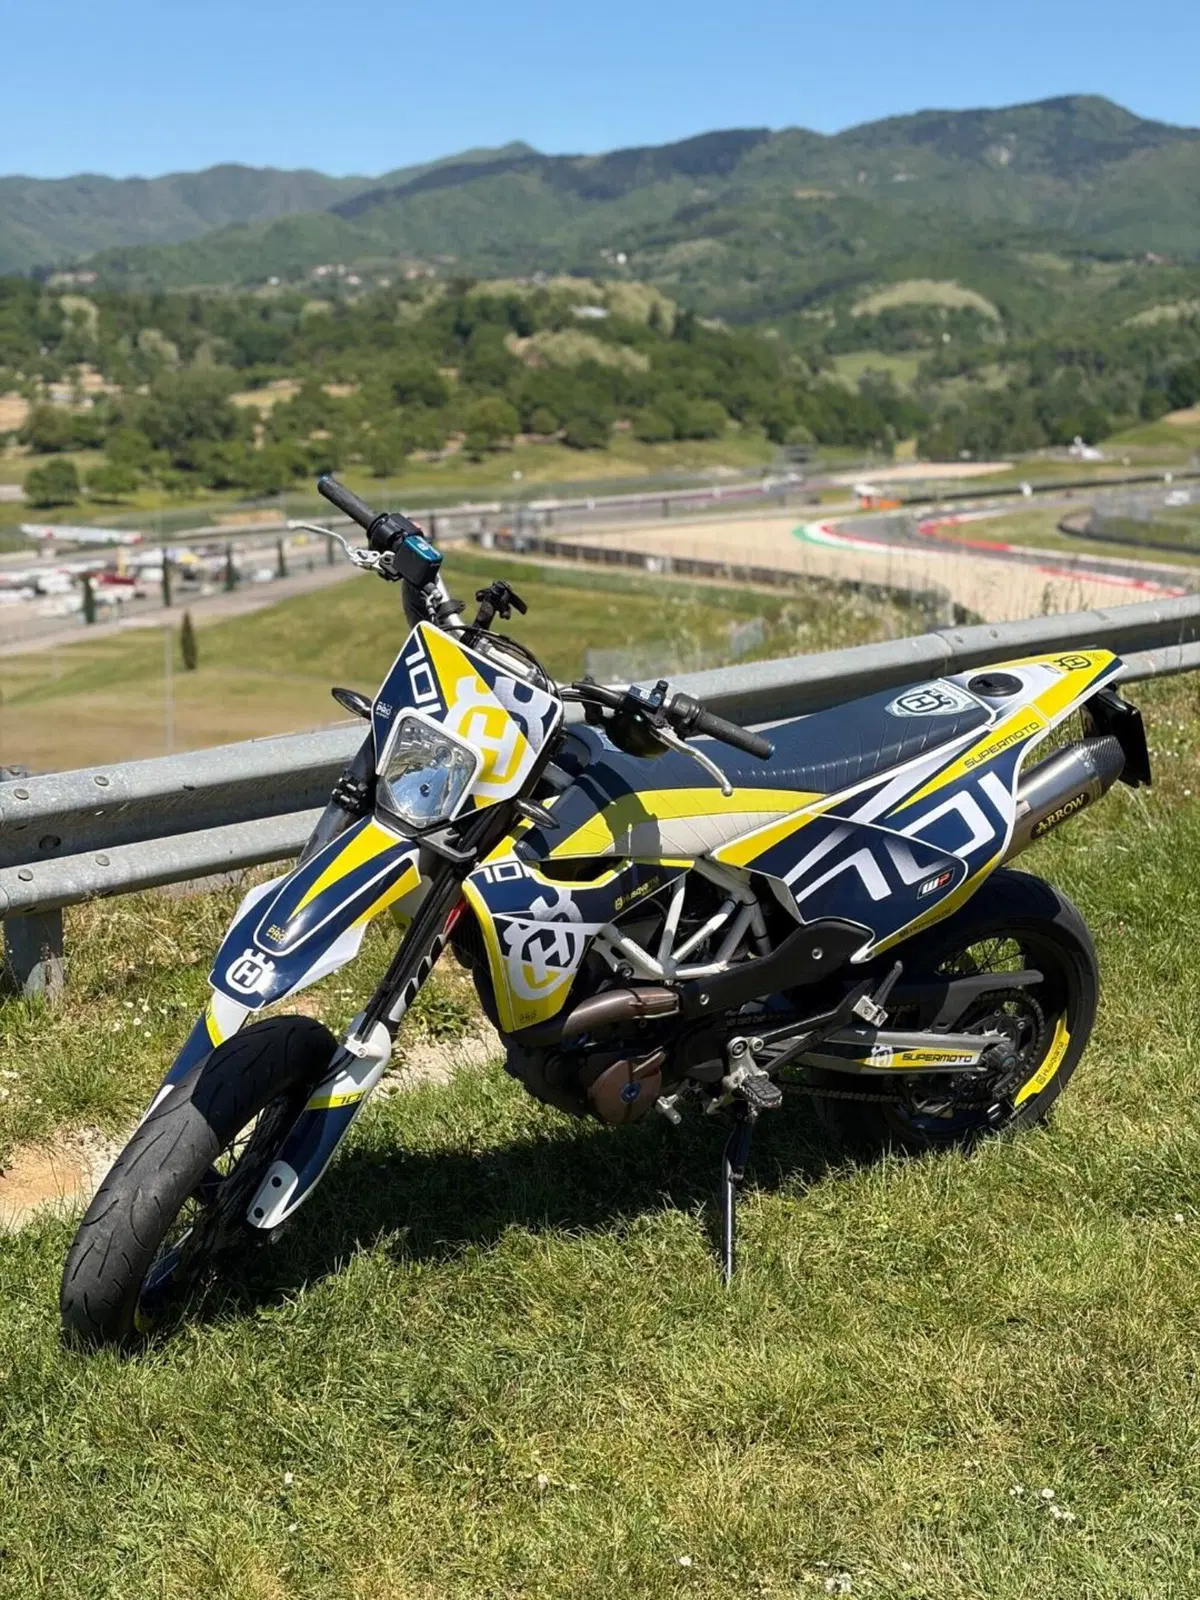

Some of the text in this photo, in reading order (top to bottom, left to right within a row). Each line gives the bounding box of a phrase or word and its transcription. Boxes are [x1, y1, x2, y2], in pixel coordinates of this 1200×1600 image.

[376, 704, 392, 716] PRO
[963, 721, 1040, 768] SUPERMOTO
[1035, 793, 1085, 834] ARROW
[623, 875, 660, 904] usqva
[901, 1052, 973, 1063] SUPERMOTO
